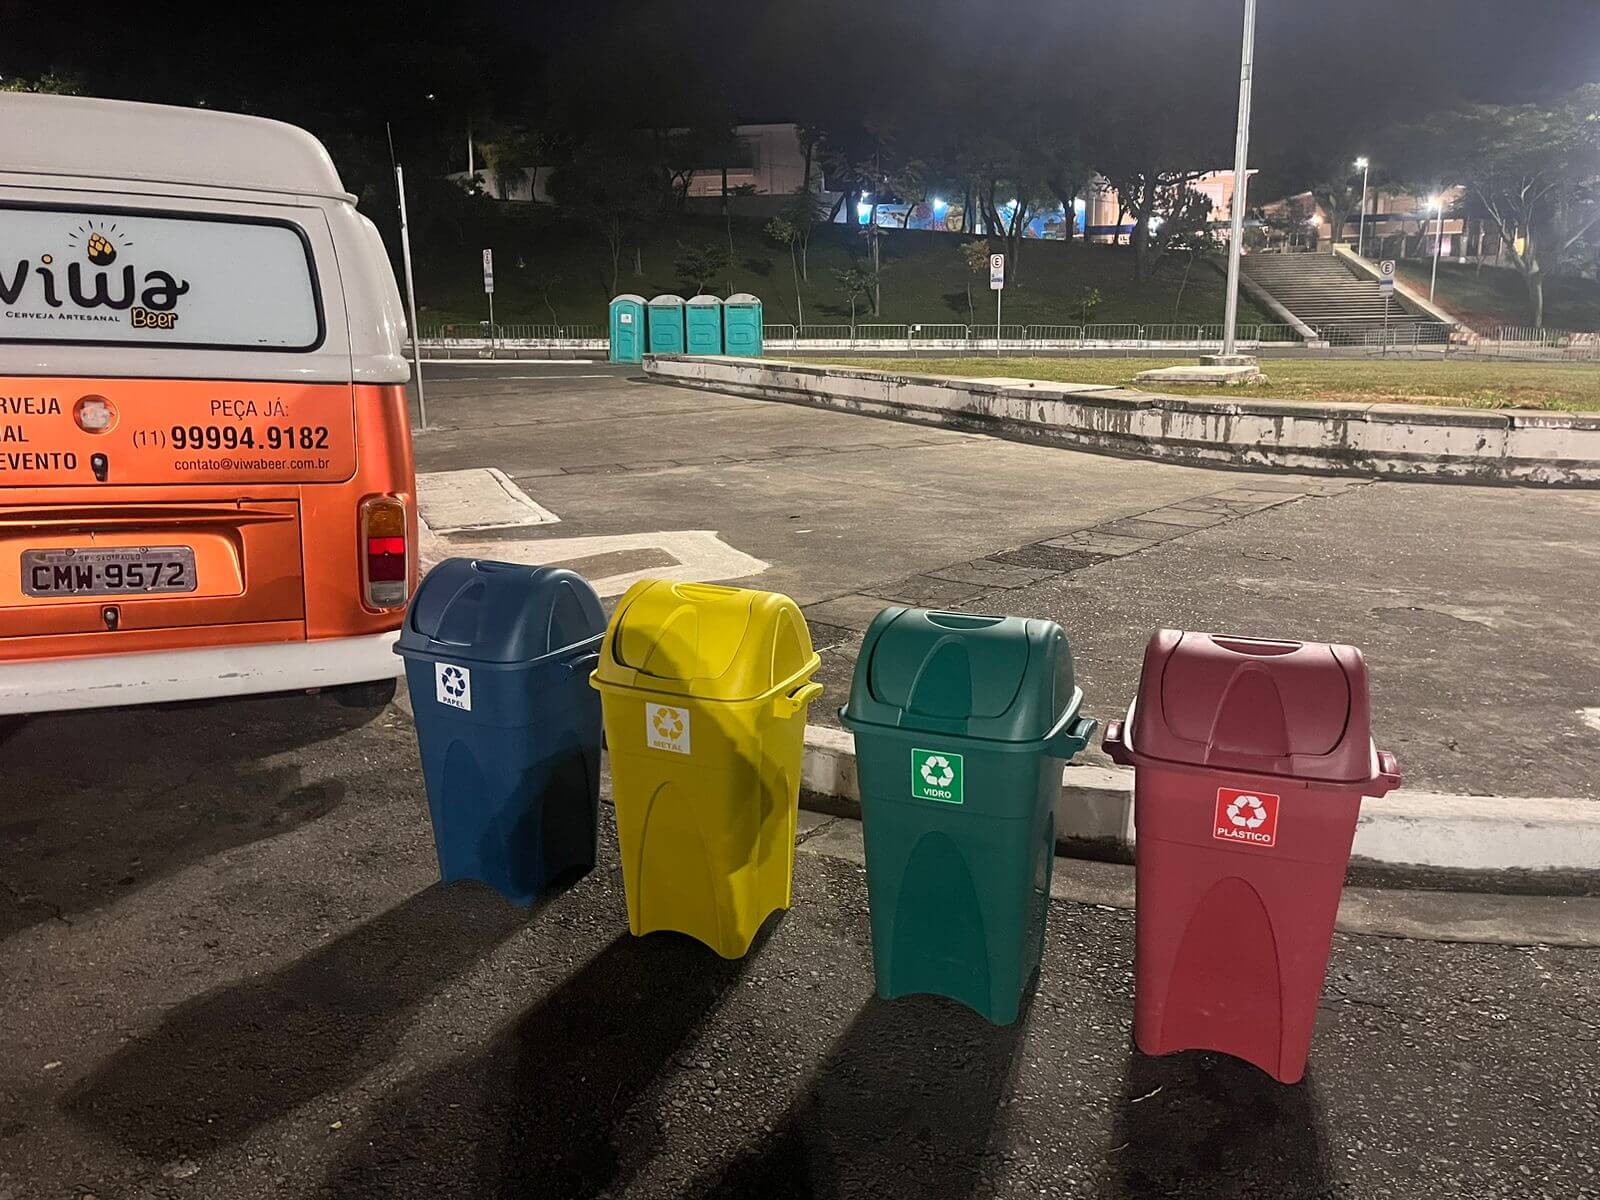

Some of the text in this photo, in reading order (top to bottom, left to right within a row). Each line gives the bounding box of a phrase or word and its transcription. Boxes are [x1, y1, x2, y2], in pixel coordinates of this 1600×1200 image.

[994, 257, 1000, 266] E
[1384, 264, 1390, 272] E
[5, 310, 121, 323] CERVEJA ARTESANAL
[131, 308, 178, 329] Beer
[210, 397, 289, 421] PEÇA JÁ:
[0, 424, 29, 443] AL
[133, 426, 329, 450] (11) 99994.9182
[174, 457, 330, 471] contato@viwabeer.com.br
[442, 696, 465, 708] PAPEL
[653, 740, 683, 751] METAL
[923, 788, 952, 799] VIDRO
[1217, 827, 1271, 842] PLÁSTICO
